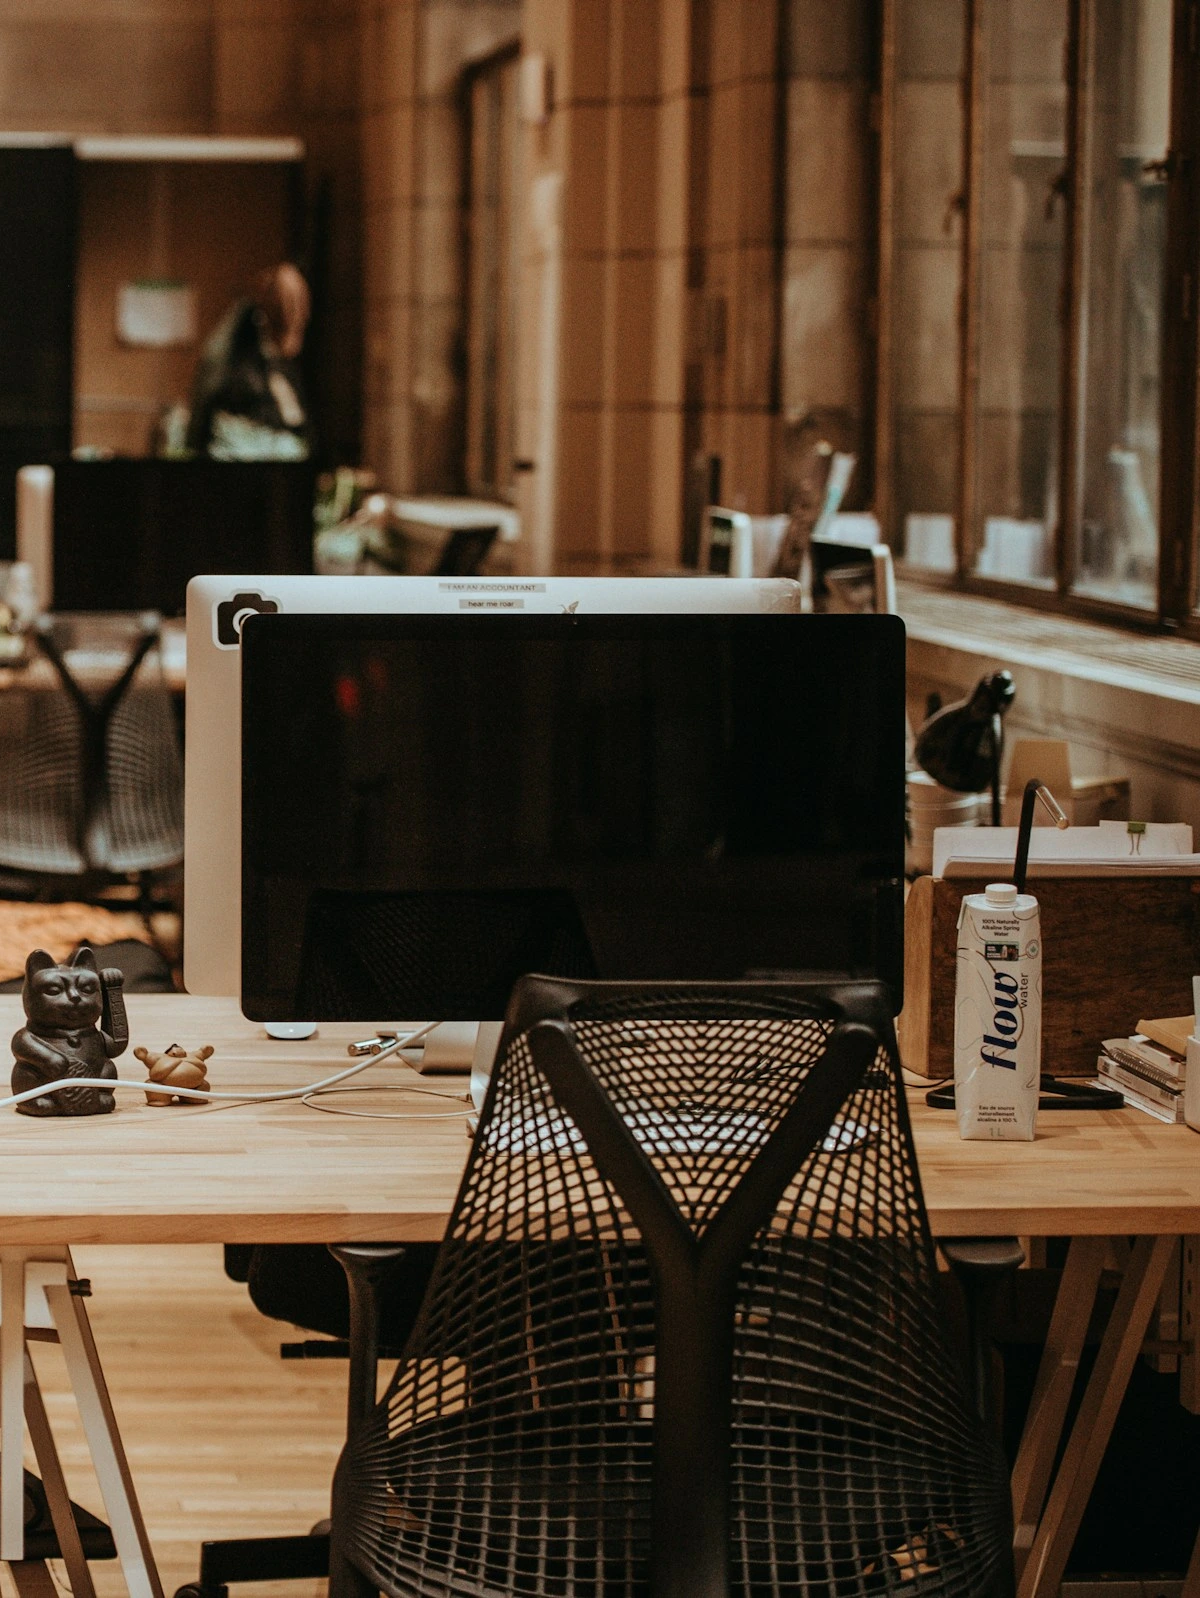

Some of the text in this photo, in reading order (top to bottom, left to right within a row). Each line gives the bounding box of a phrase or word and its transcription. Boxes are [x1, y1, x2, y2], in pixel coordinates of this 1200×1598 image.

[1019, 972, 1029, 1009] water
[980, 972, 1019, 1070] flow
[989, 1127, 1004, 1136] 1 L
